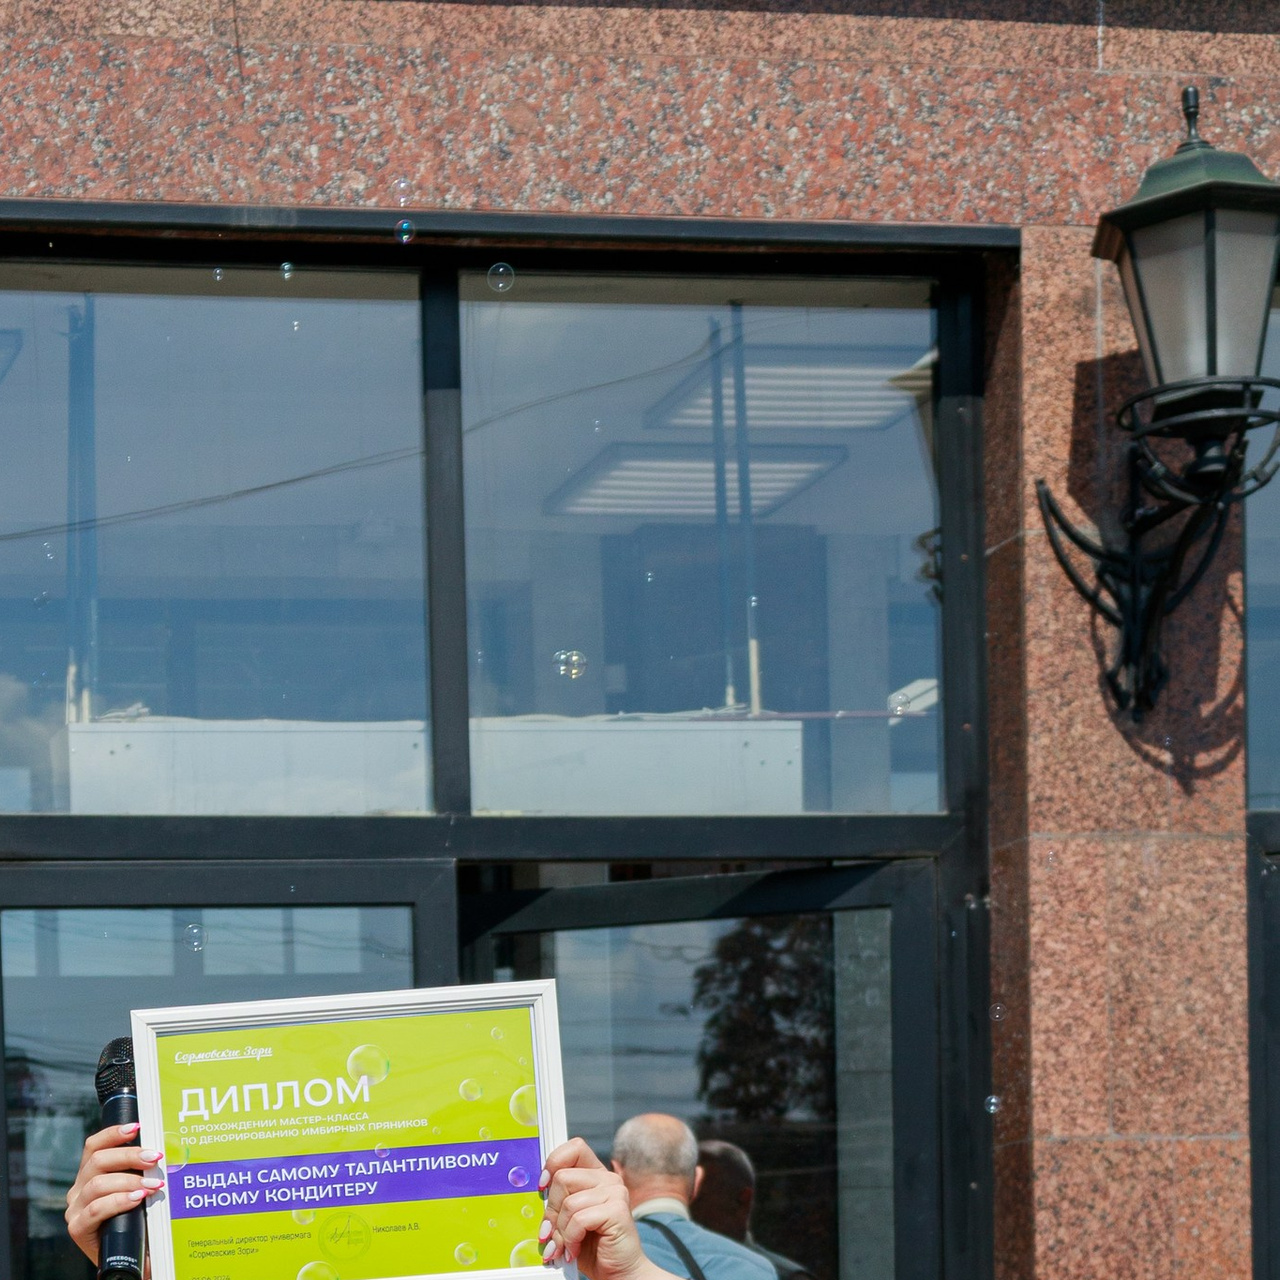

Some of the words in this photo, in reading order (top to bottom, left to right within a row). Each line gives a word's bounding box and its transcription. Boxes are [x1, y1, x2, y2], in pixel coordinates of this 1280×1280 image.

[175, 1048, 241, 1066] Сормовские
[243, 1046, 273, 1061] Зори
[178, 1075, 370, 1122] ДИПЛОМ
[180, 1126, 188, 1134] О
[191, 1119, 277, 1132] ПРОХОЖДЕНИИ
[279, 1112, 369, 1127] МАСТЕР-КЛАССА
[180, 1137, 197, 1145] ПО
[199, 1129, 299, 1145] ДЕКОРИРОВАНИЮ
[302, 1123, 365, 1136] ИМБИРНЫХ
[368, 1119, 428, 1131] ПРЯНИКОВ
[183, 1171, 252, 1189] ВЫДАН
[257, 1164, 340, 1183] САМОМУ
[345, 1152, 500, 1177] ТАЛАНТЛИВОМУ
[184, 1190, 260, 1209] ЮНОМУ
[265, 1181, 378, 1203] КОНДИТЕРУ
[187, 1236, 234, 1248] Генеральный
[235, 1234, 269, 1245] директор
[270, 1231, 312, 1243] универмага
[372, 1225, 407, 1233] Николаев
